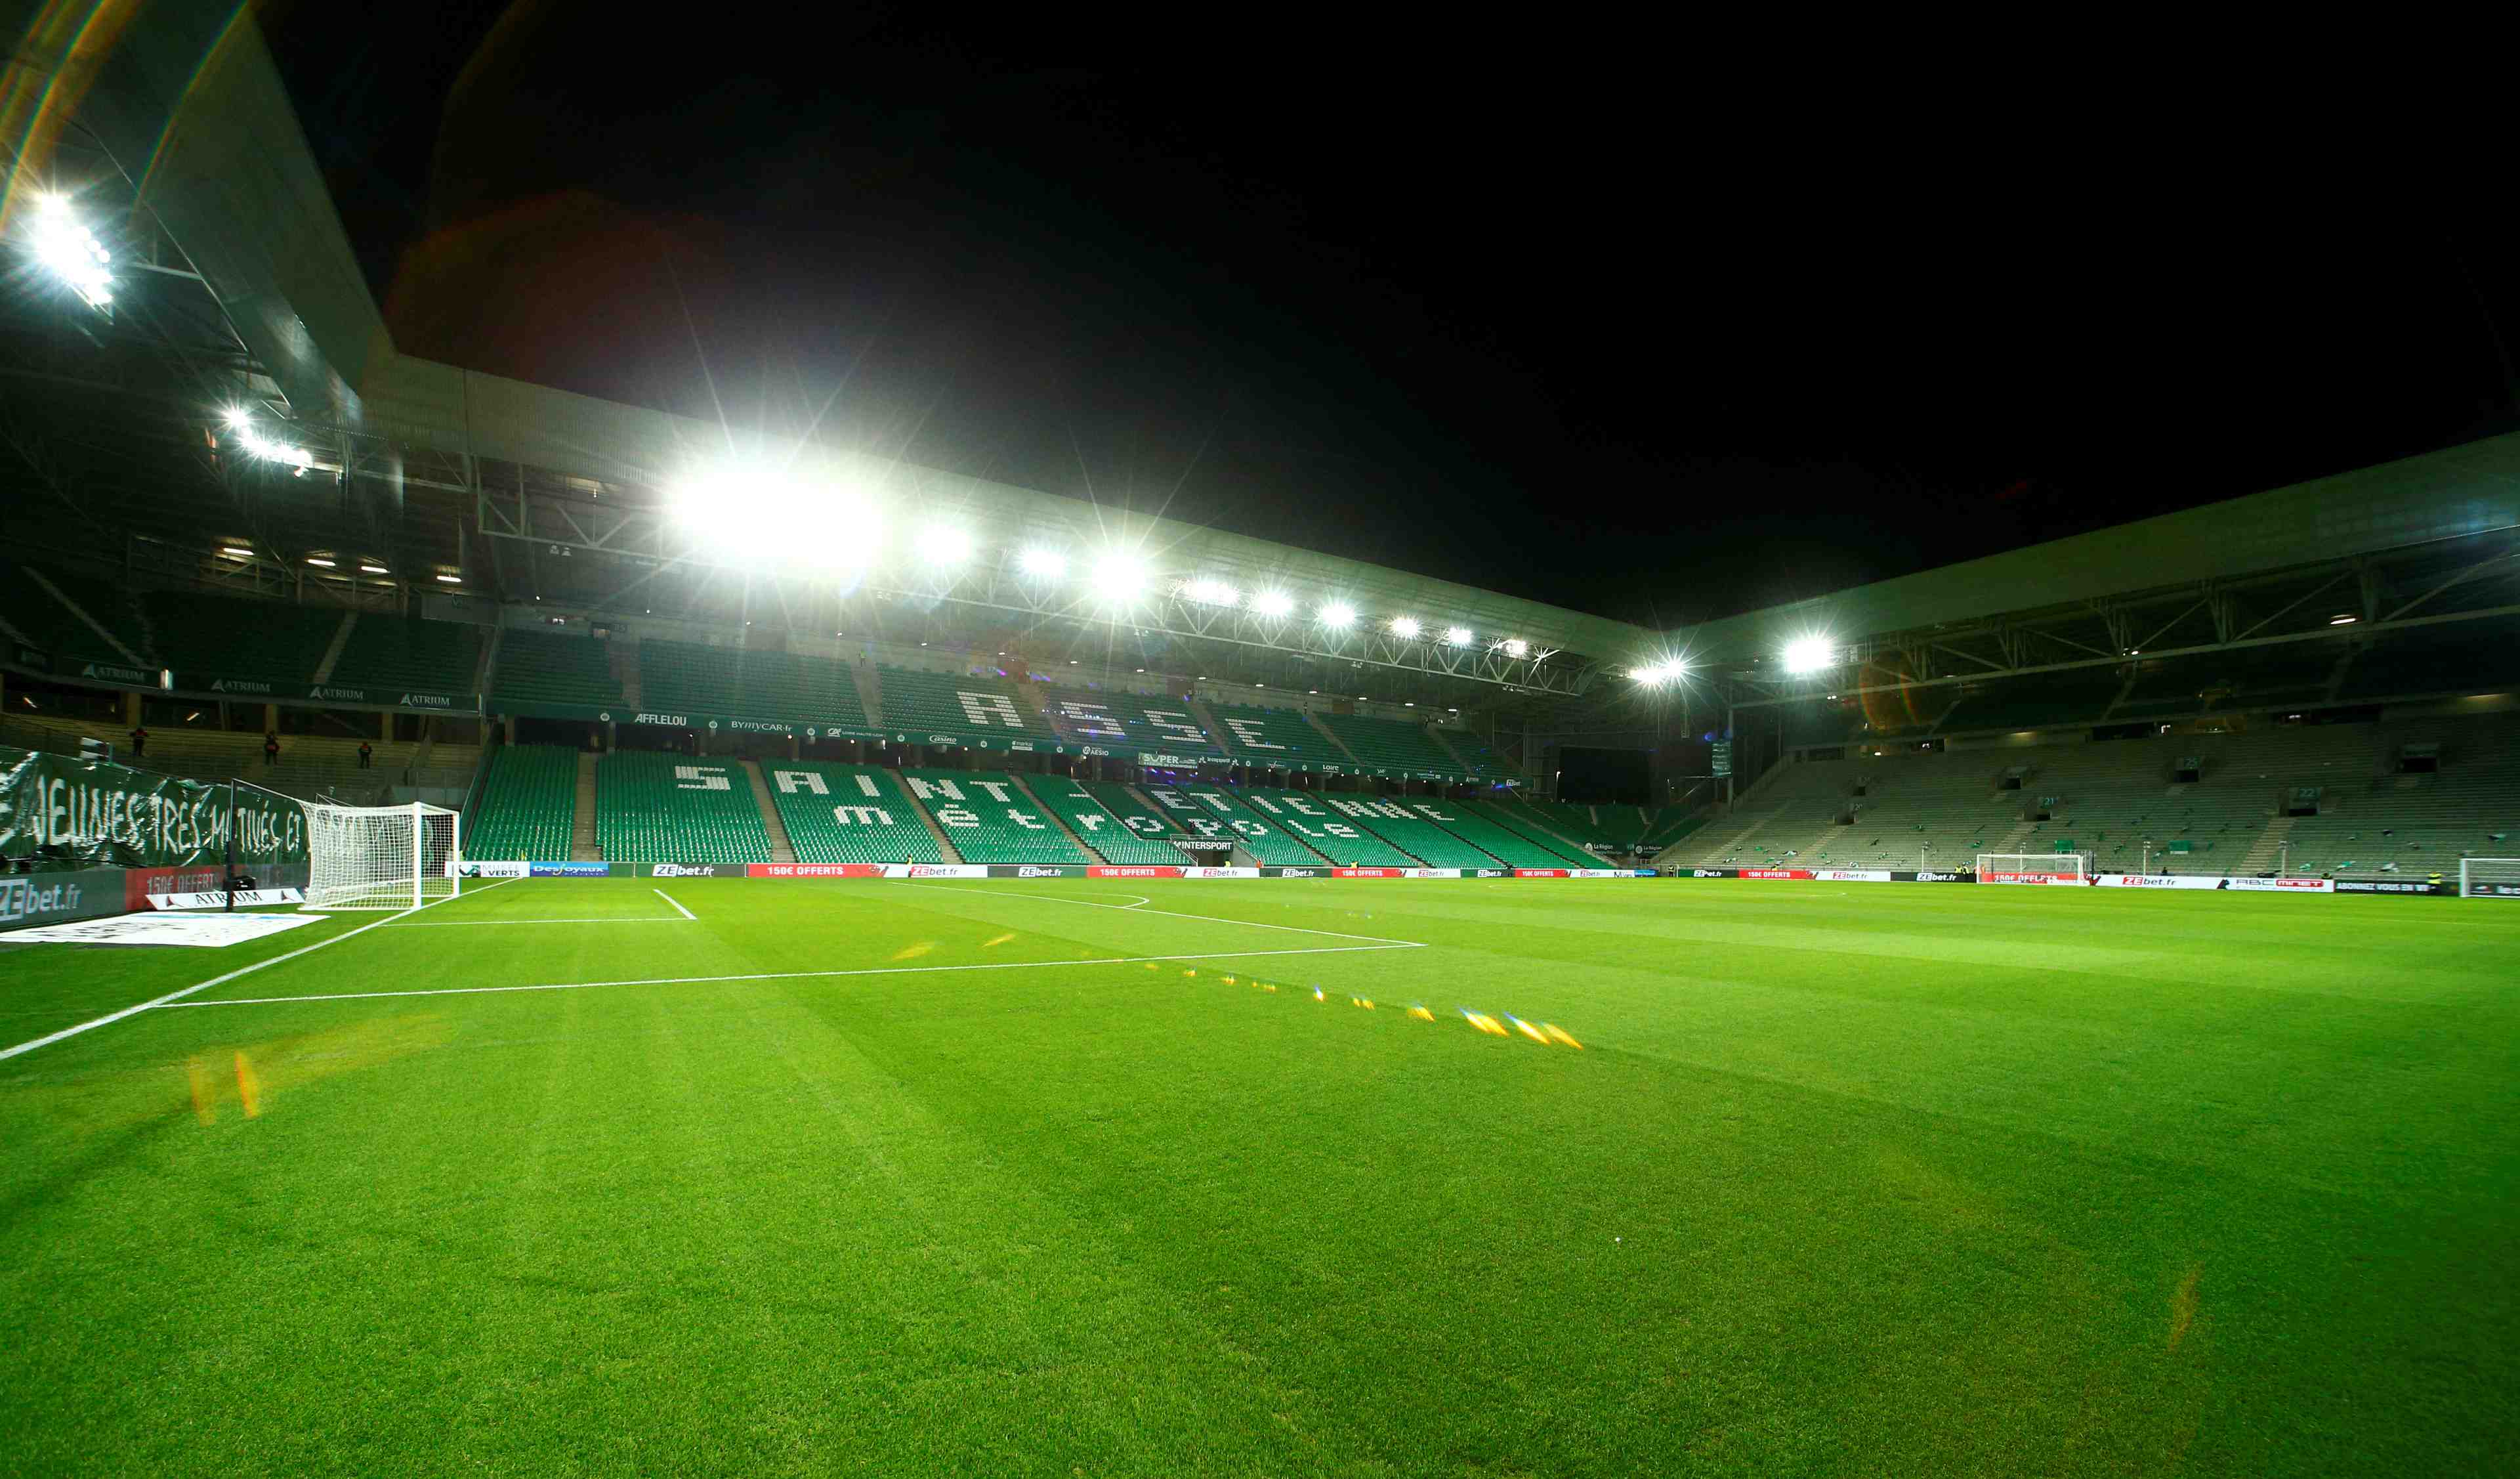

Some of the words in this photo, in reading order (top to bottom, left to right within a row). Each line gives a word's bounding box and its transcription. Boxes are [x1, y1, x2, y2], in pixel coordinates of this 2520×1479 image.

[224, 680, 271, 694] ATRIUM
[322, 689, 364, 700] ATRIUM
[412, 694, 450, 706] ATRIUM
[635, 713, 687, 726] AFFLELOU
[956, 691, 1287, 750] ASSE
[1181, 840, 1232, 851] INTERSPORT
[767, 866, 793, 876] 150€
[797, 866, 844, 876] OFFERTS
[911, 866, 958, 876] ZEbet.fr
[1018, 866, 1062, 877] ZEbet.fr
[1202, 868, 1238, 877] ZEbet.fr
[1282, 868, 1314, 877] ZEbet.fr
[1916, 872, 1957, 882] ZEbet.fr
[2122, 876, 2177, 886] ZEbet.fr
[146, 875, 175, 894] 150€
[195, 891, 264, 905] ATRUM
